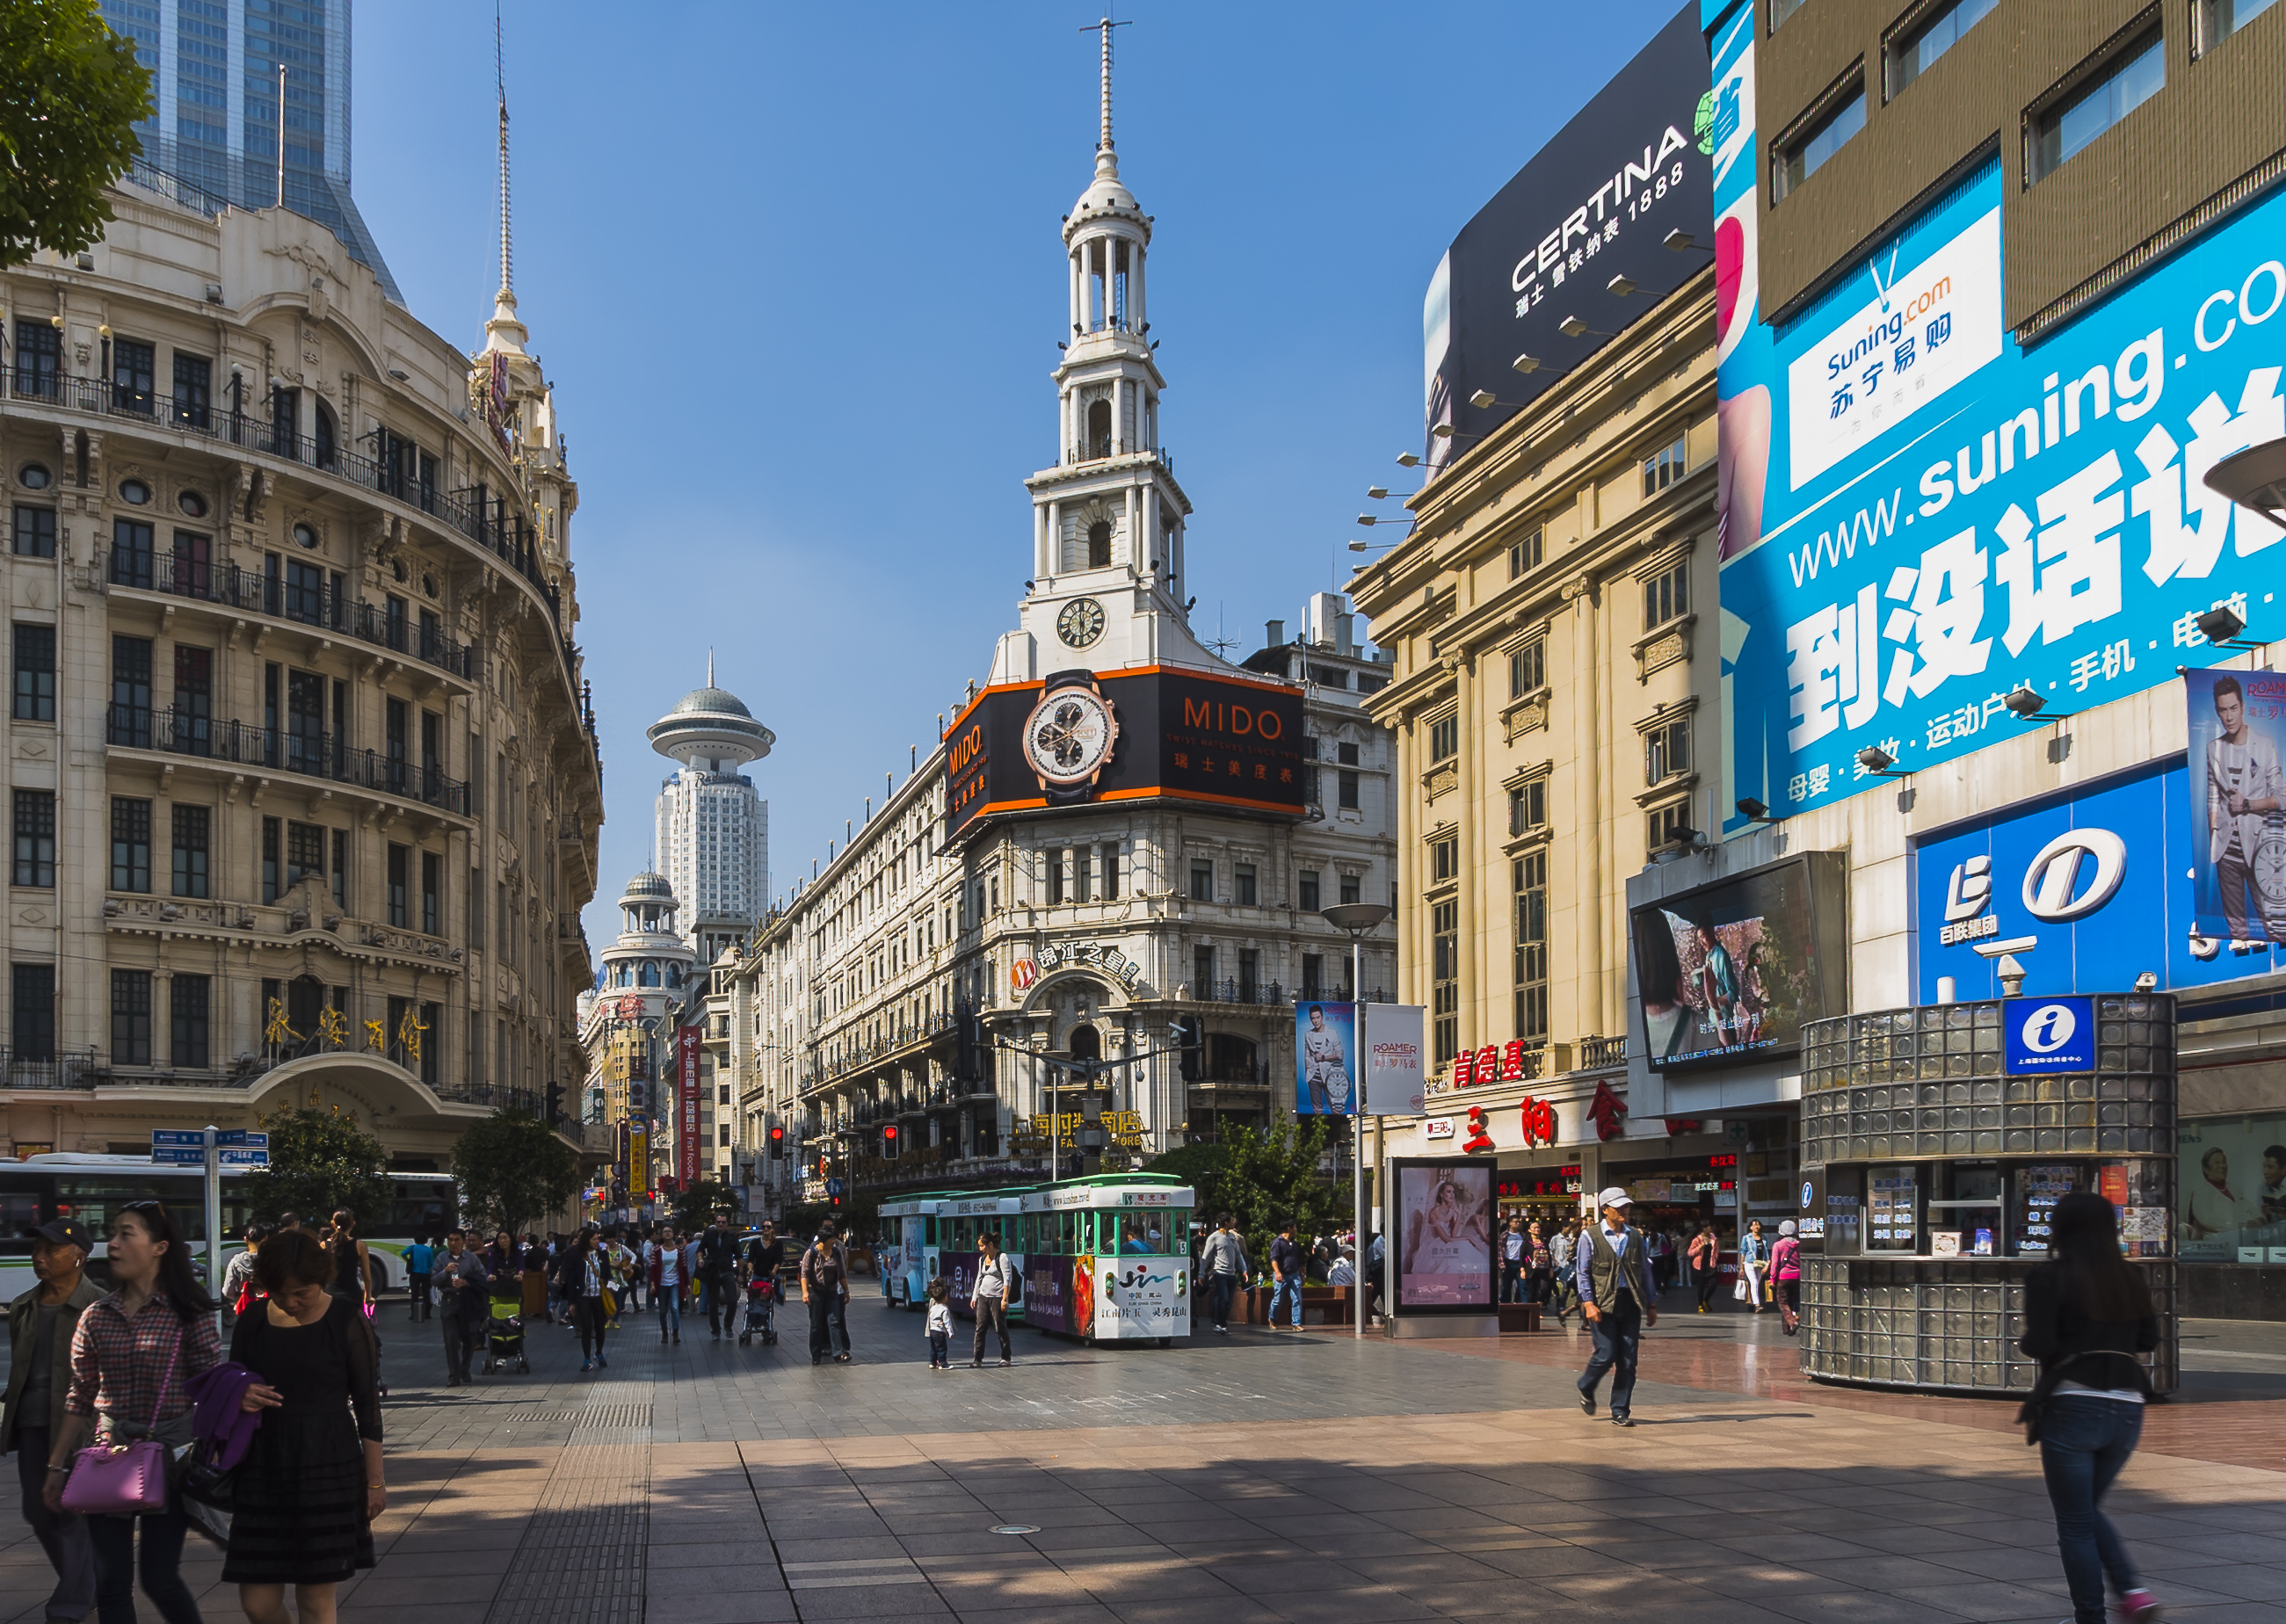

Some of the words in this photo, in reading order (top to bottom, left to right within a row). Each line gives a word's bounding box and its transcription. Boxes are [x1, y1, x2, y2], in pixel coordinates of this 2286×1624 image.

[1512, 125, 1687, 293] CERTINA
[1515, 283, 1544, 319] 瑞士
[1552, 216, 1620, 288] 雪铁纳表
[1628, 161, 1683, 221] 1888
[1828, 276, 1950, 381] Suning.com
[1830, 311, 1951, 420] 苏宁易购
[1787, 365, 2286, 753] 到没话说
[1184, 697, 1281, 740] MIDO
[949, 725, 981, 779] MIDO
[1166, 733, 1195, 745] SWISS
[1201, 738, 1243, 753] WATCHES
[1247, 745, 1275, 757] SINCE
[1174, 752, 1293, 783] 瑞士美度表
[1939, 914, 1999, 945] 百联集团
[1037, 941, 1127, 975] 锦江之星
[1373, 1042, 1417, 1055] ROAMER
[1454, 1039, 1526, 1089] 肯德基
[1180, 1243, 1187, 1255] 5
[1432, 1247, 1460, 1256] 盛大开幕
[1152, 1306, 1187, 1318] 灵秀昆山
